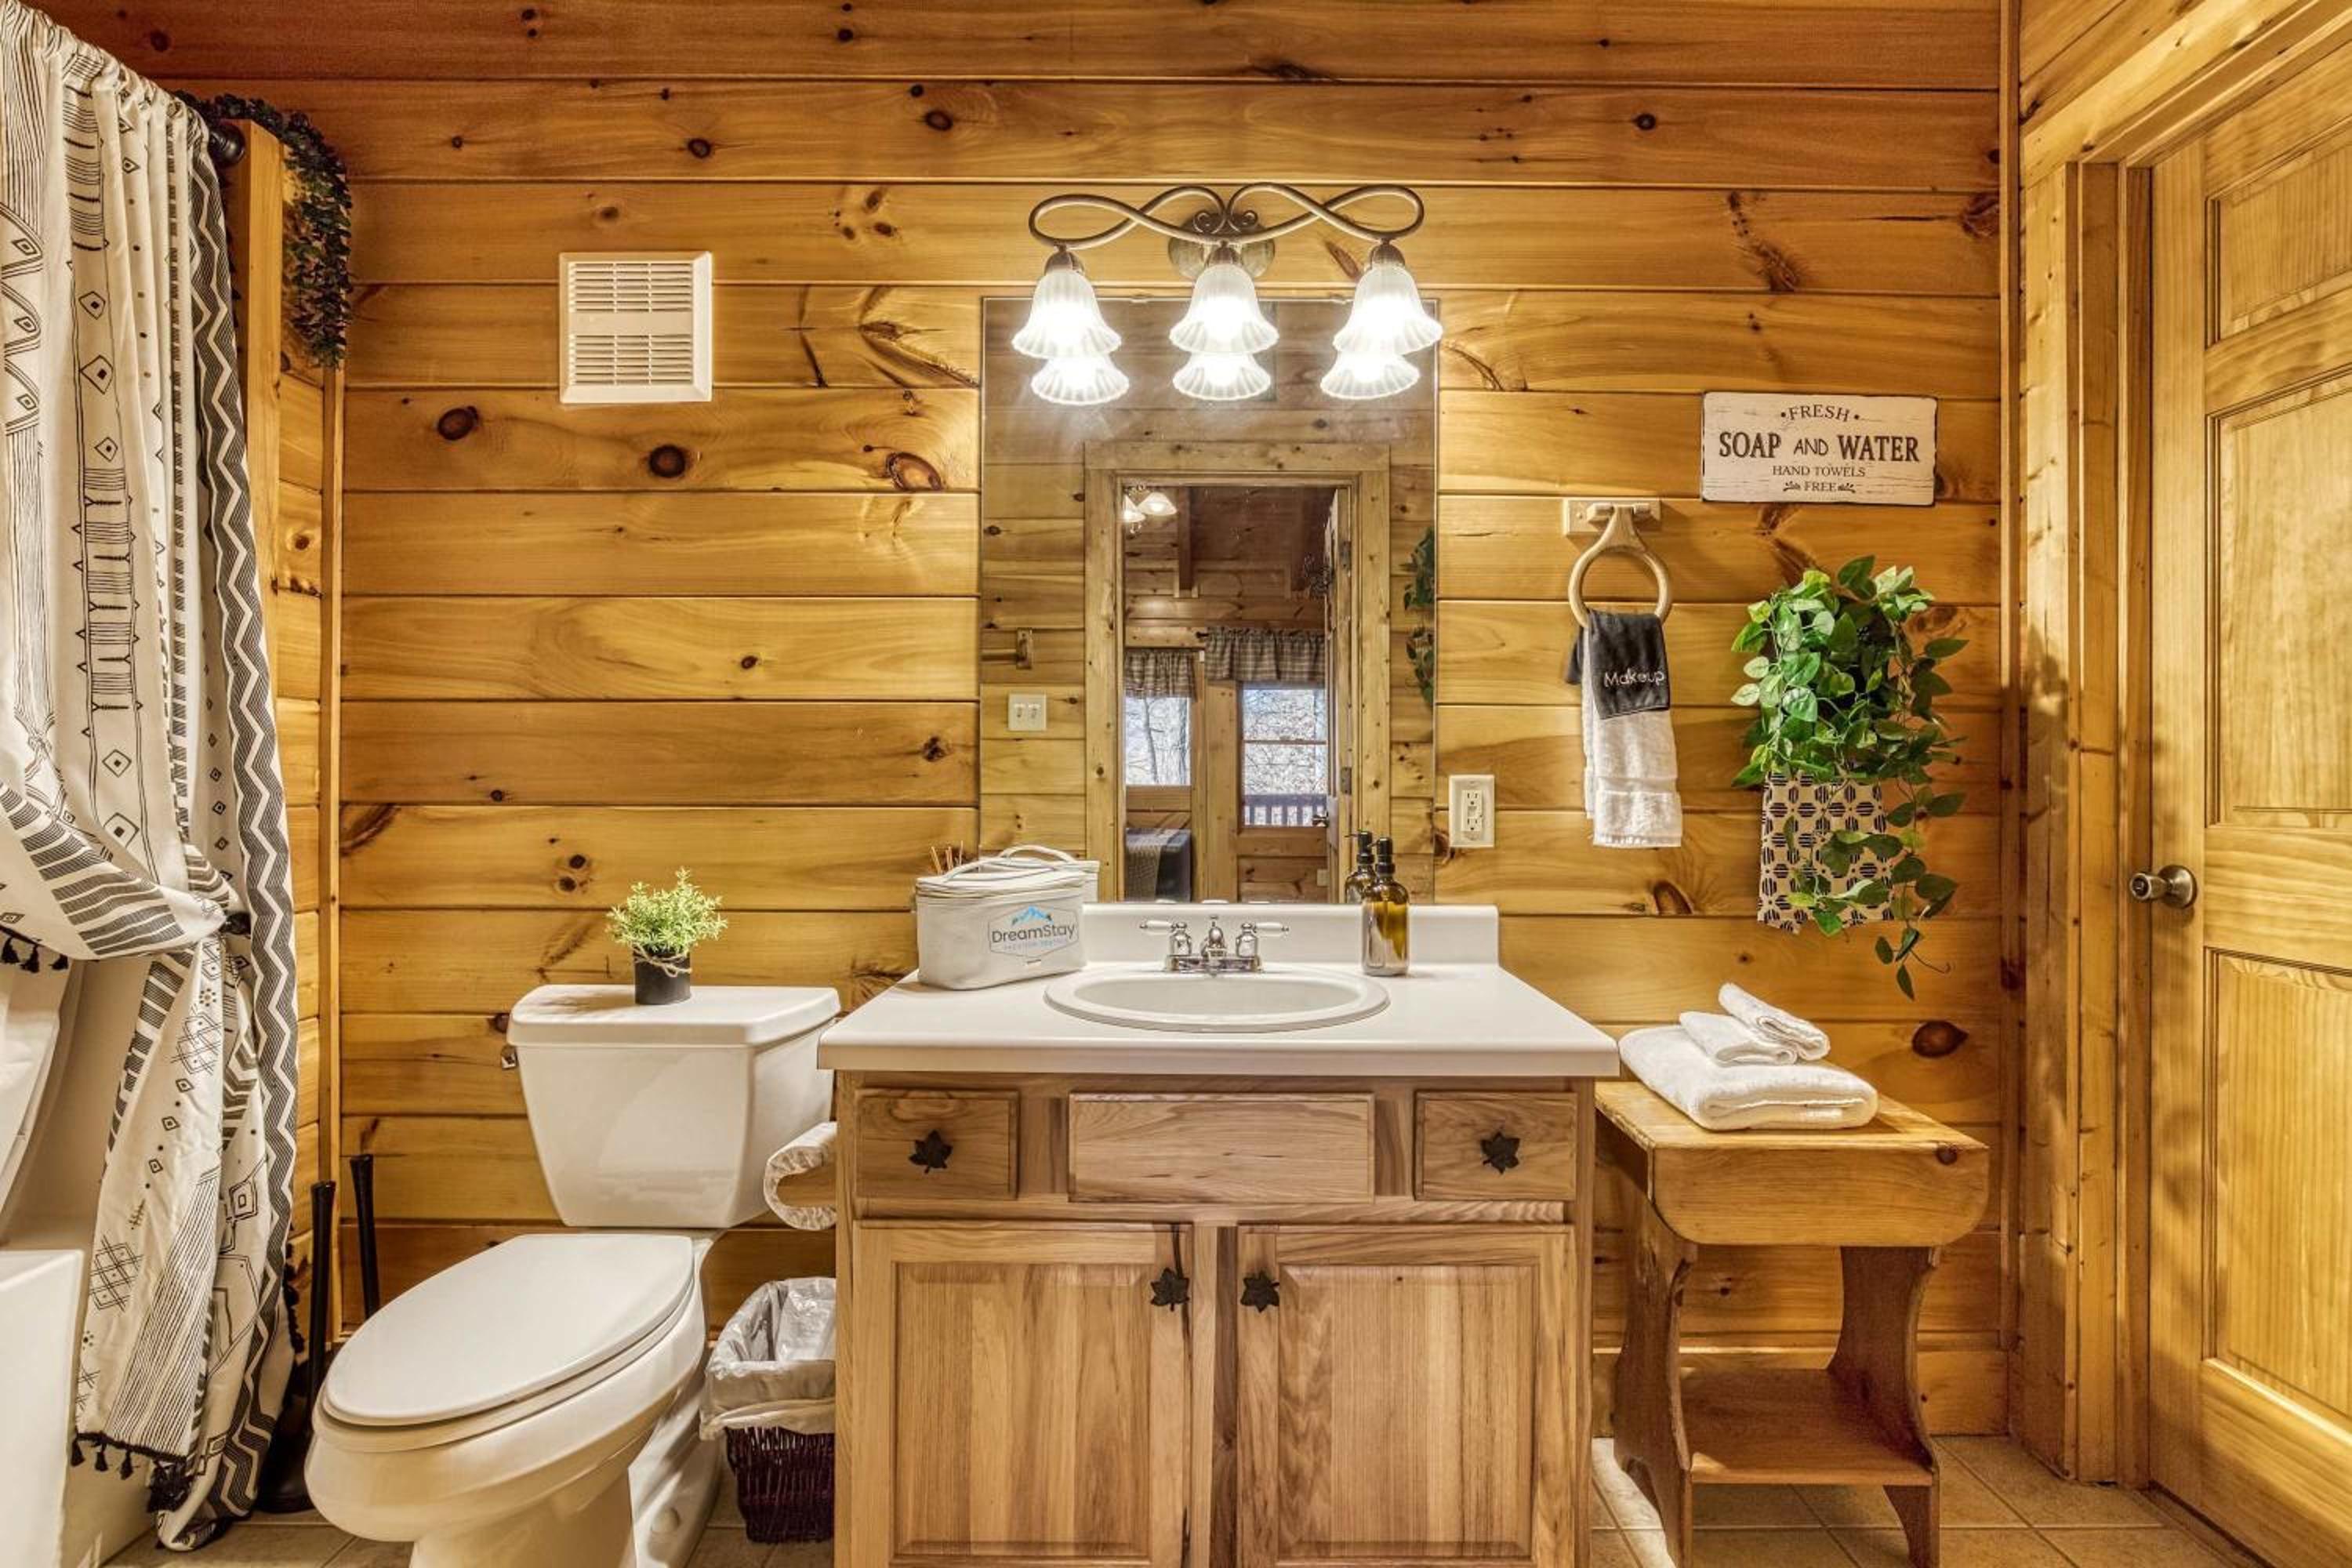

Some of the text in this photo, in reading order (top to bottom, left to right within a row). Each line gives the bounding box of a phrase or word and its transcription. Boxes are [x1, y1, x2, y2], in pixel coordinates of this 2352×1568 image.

[1788, 404, 1850, 422] FRESH
[1719, 431, 1920, 462] SOAP AND WATER
[1772, 465, 1866, 477] HAND TOWELS
[1804, 481, 1837, 492] FREE
[1604, 667, 1665, 688] Makeup
[992, 924, 1075, 943] DreamStay
